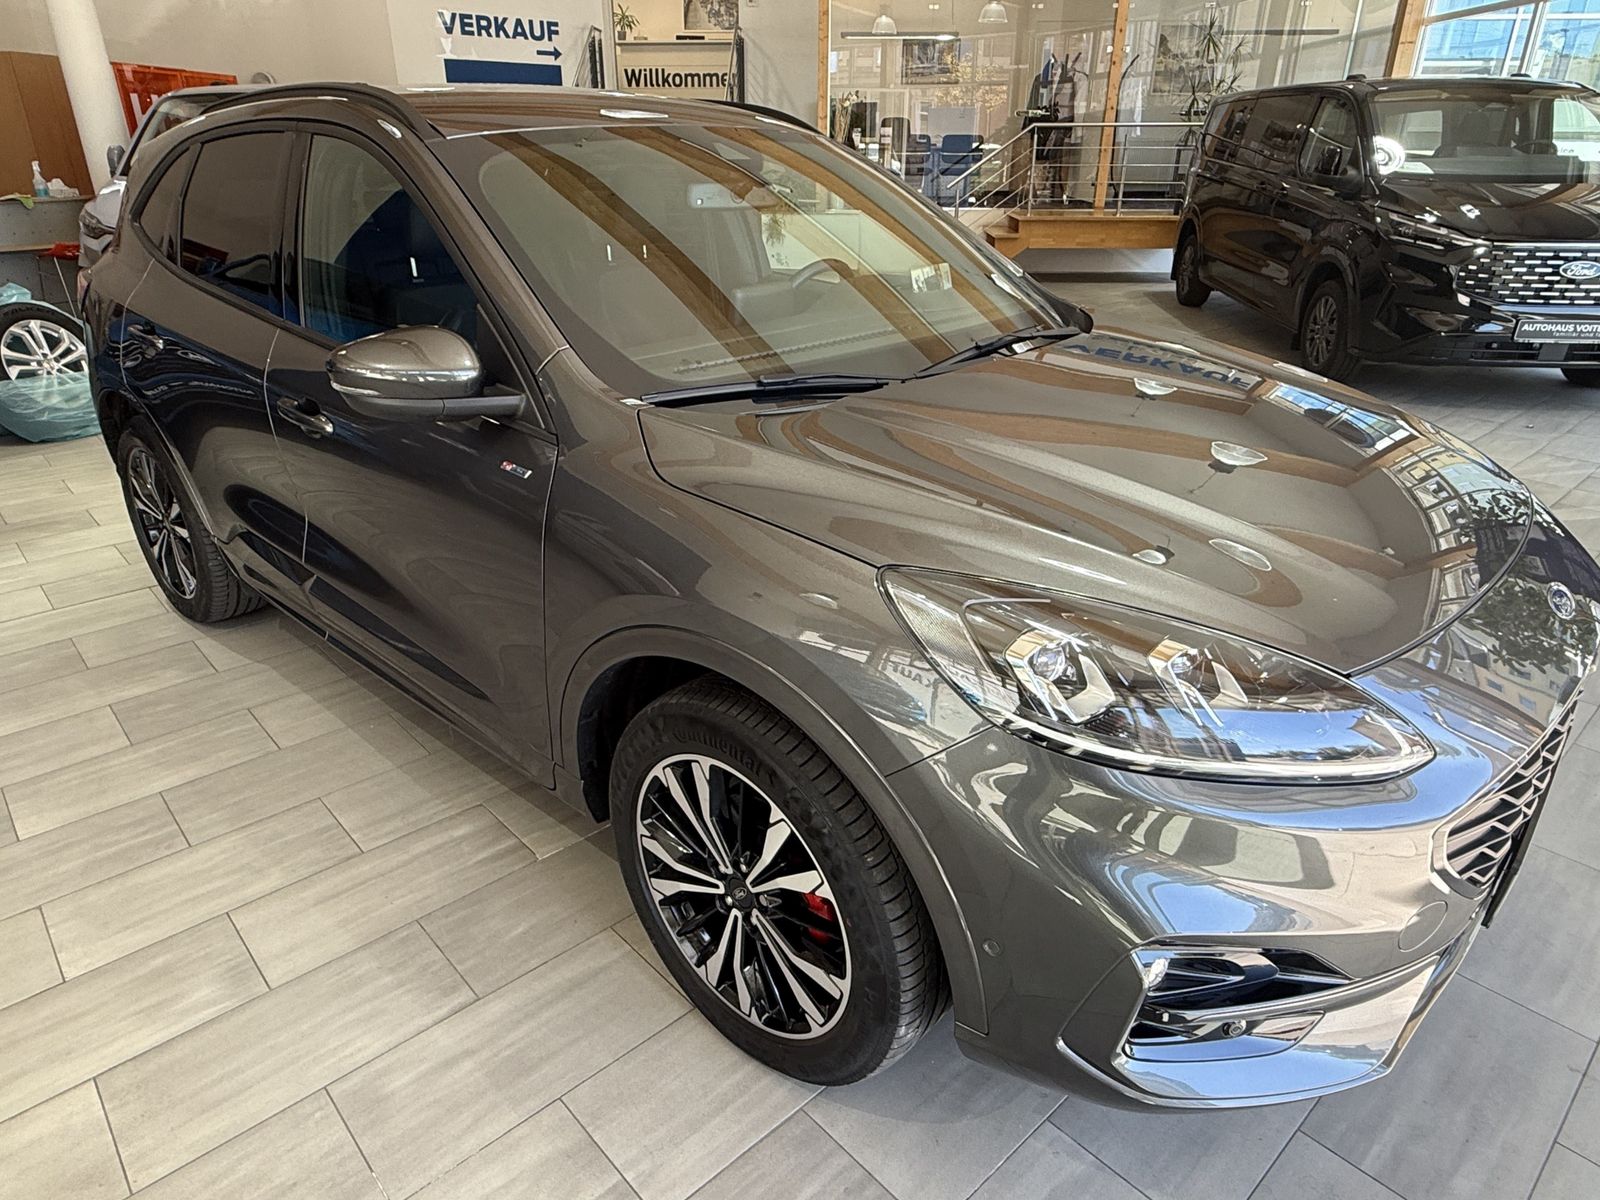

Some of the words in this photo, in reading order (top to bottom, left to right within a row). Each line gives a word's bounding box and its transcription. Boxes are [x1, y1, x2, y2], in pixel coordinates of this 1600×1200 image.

[437, 11, 559, 42] VERKAUF
[1567, 263, 1597, 276] Ford
[1521, 323, 1574, 332] AUTOHAUS
[672, 728, 762, 777] Continental
